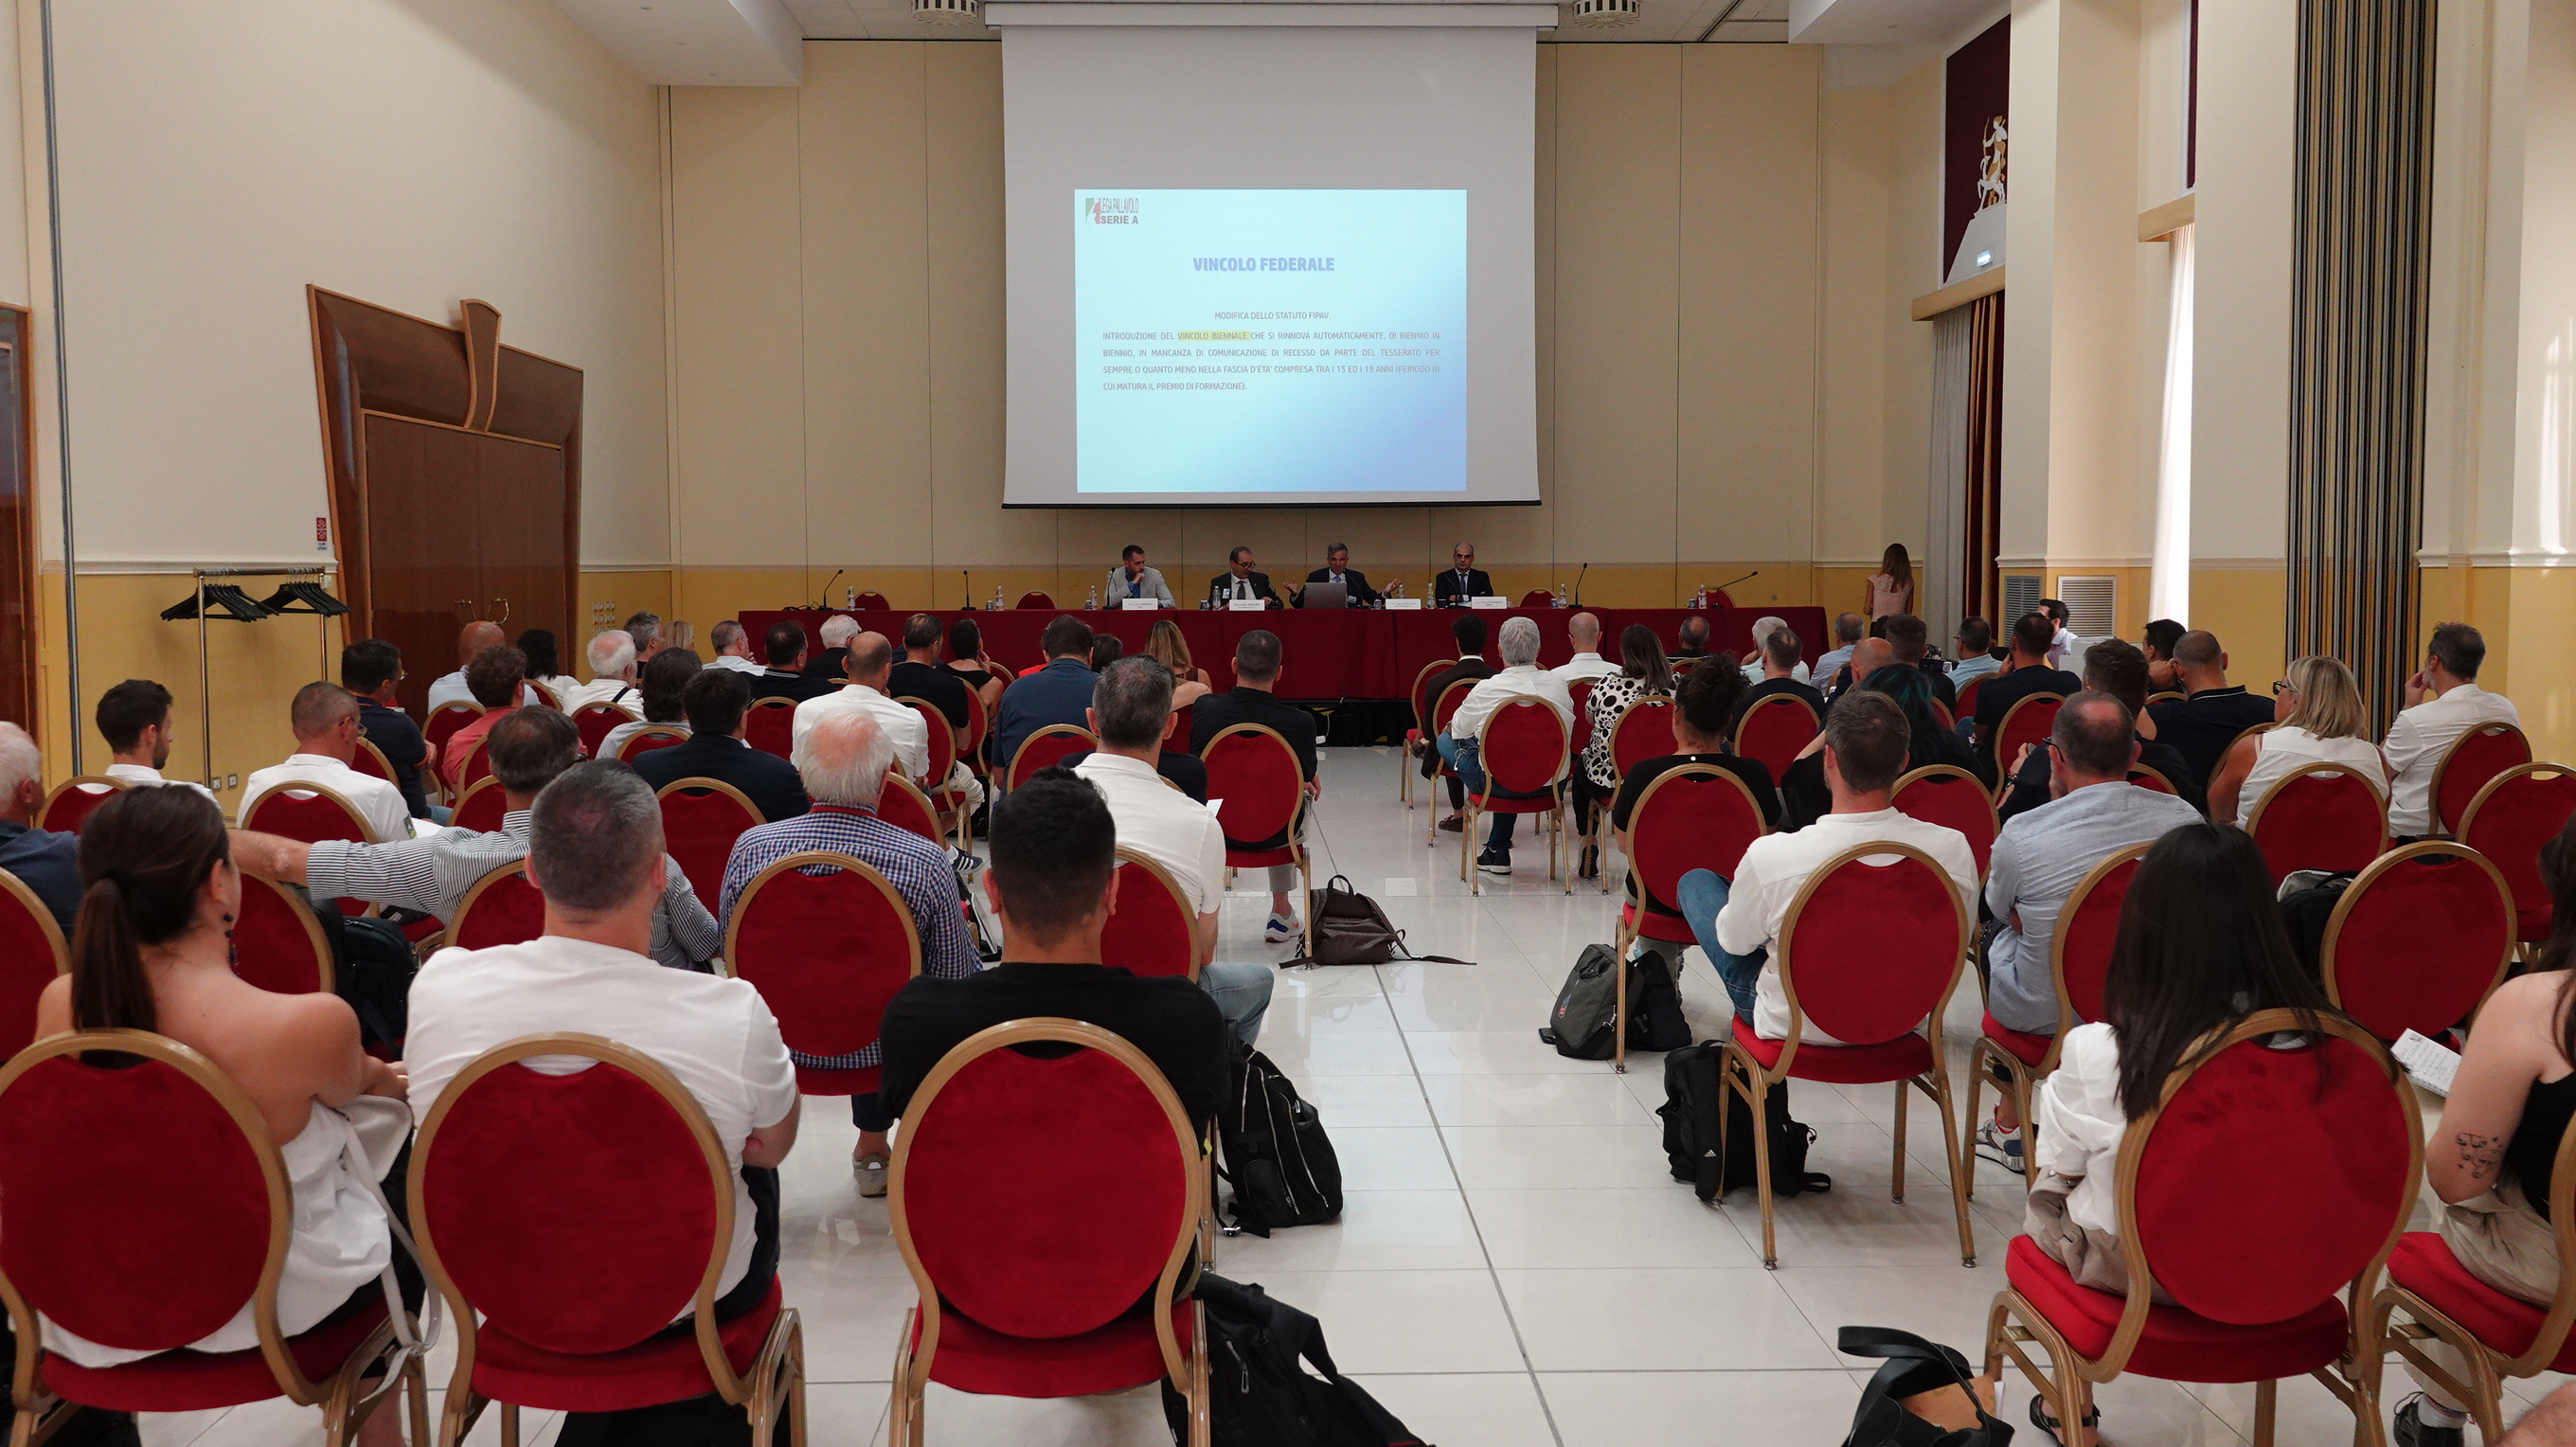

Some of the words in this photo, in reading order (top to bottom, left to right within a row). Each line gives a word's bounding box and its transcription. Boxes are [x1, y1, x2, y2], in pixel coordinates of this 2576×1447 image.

[1100, 215, 1129, 223] SERIE
[1132, 215, 1138, 223] A
[1192, 257, 1257, 272] VINCOLO
[1260, 257, 1335, 272] FEDERALE
[1214, 312, 1249, 320] MODIFICA
[1250, 312, 1274, 320] DELLO
[1275, 312, 1308, 320] STATUTO
[1102, 331, 1157, 341] INTRODUZIONE
[1160, 331, 1174, 340] DEL
[1177, 331, 1209, 340] VINCOLO
[1211, 331, 1247, 340] BIENNALE
[1250, 331, 1265, 340] CHE
[1267, 331, 1275, 340] SI
[1278, 331, 1311, 340] RINNOVA
[1313, 331, 1386, 341] AUTOMATICAMENTE,
[1389, 331, 1397, 340] DI
[1400, 331, 1429, 340] BIENNIO
[1102, 348, 1136, 359] BIENNIO,
[1151, 348, 1192, 357] MANCANZA
[1196, 348, 1204, 357] DI
[1208, 348, 1267, 357] COMUNICAZIONE
[1271, 348, 1279, 357] DI
[1283, 348, 1316, 357] RECESSO
[1319, 348, 1331, 357] DA
[1362, 348, 1376, 357] DEL
[1380, 348, 1422, 357] TESSERATO
[1425, 348, 1440, 357] PER
[1102, 366, 1133, 374] SEMPRE
[1135, 366, 1141, 374] O
[1142, 366, 1173, 375] QUANTO
[1174, 366, 1197, 374] MENO
[1198, 366, 1222, 374] NELLA
[1223, 365, 1248, 373] FASCIA
[1274, 365, 1314, 373] COMPRESA
[1315, 365, 1331, 373] TRA
[1336, 365, 1346, 373] 15
[1348, 365, 1358, 373] ED
[1395, 365, 1430, 373] (PERIODO
[1103, 383, 1116, 391] CUI
[1194, 382, 1247, 391] FORMAZIONE).
